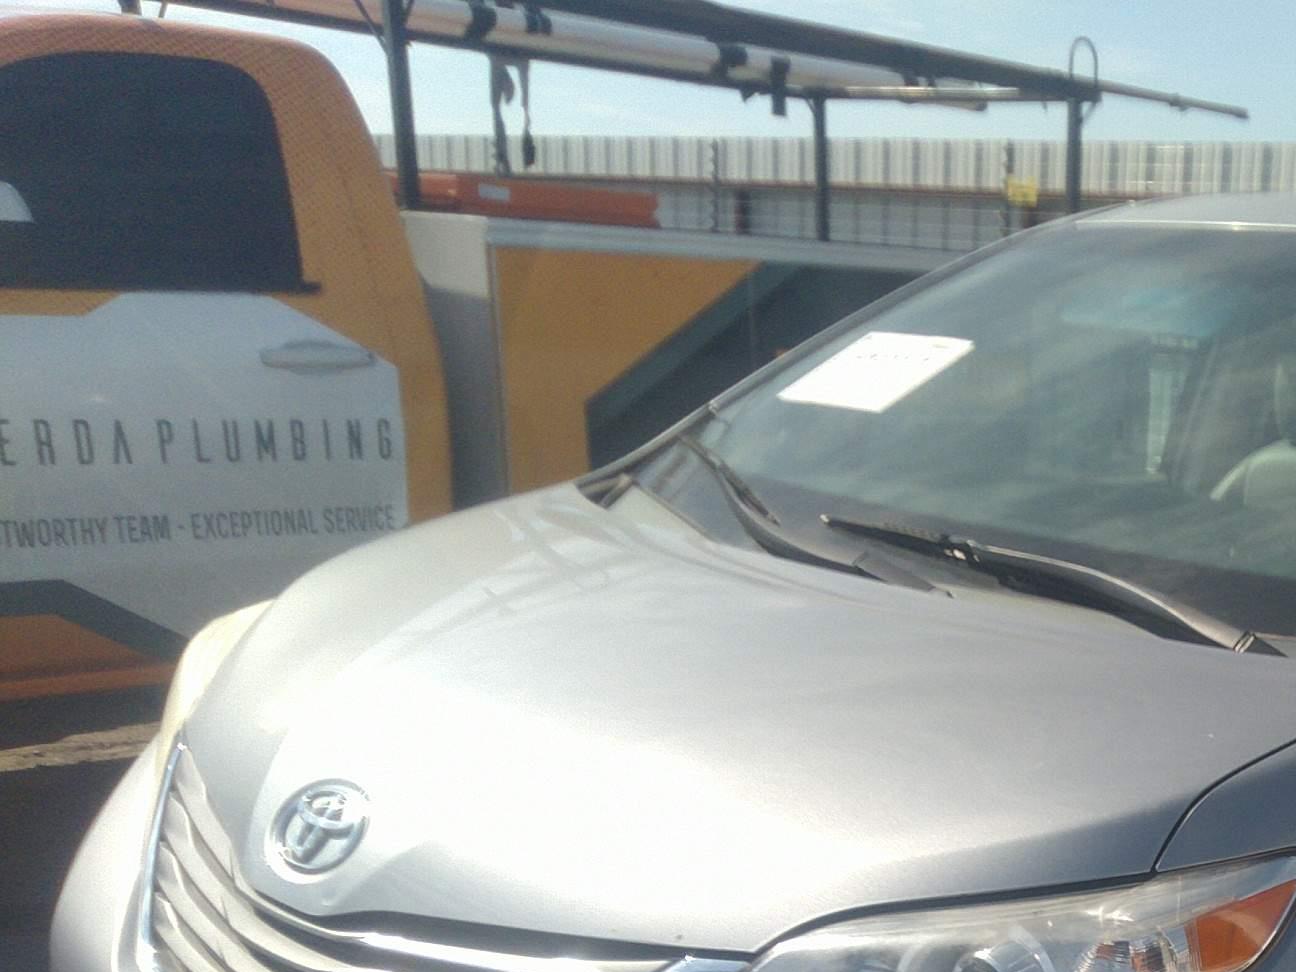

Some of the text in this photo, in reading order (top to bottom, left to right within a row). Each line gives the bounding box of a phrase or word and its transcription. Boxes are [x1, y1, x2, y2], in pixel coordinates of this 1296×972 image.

[155, 417, 392, 464] PLUMBING
[113, 514, 171, 544] TEAM
[191, 509, 319, 540] EXCEPTIONAL
[323, 504, 396, 534] SERVICE
